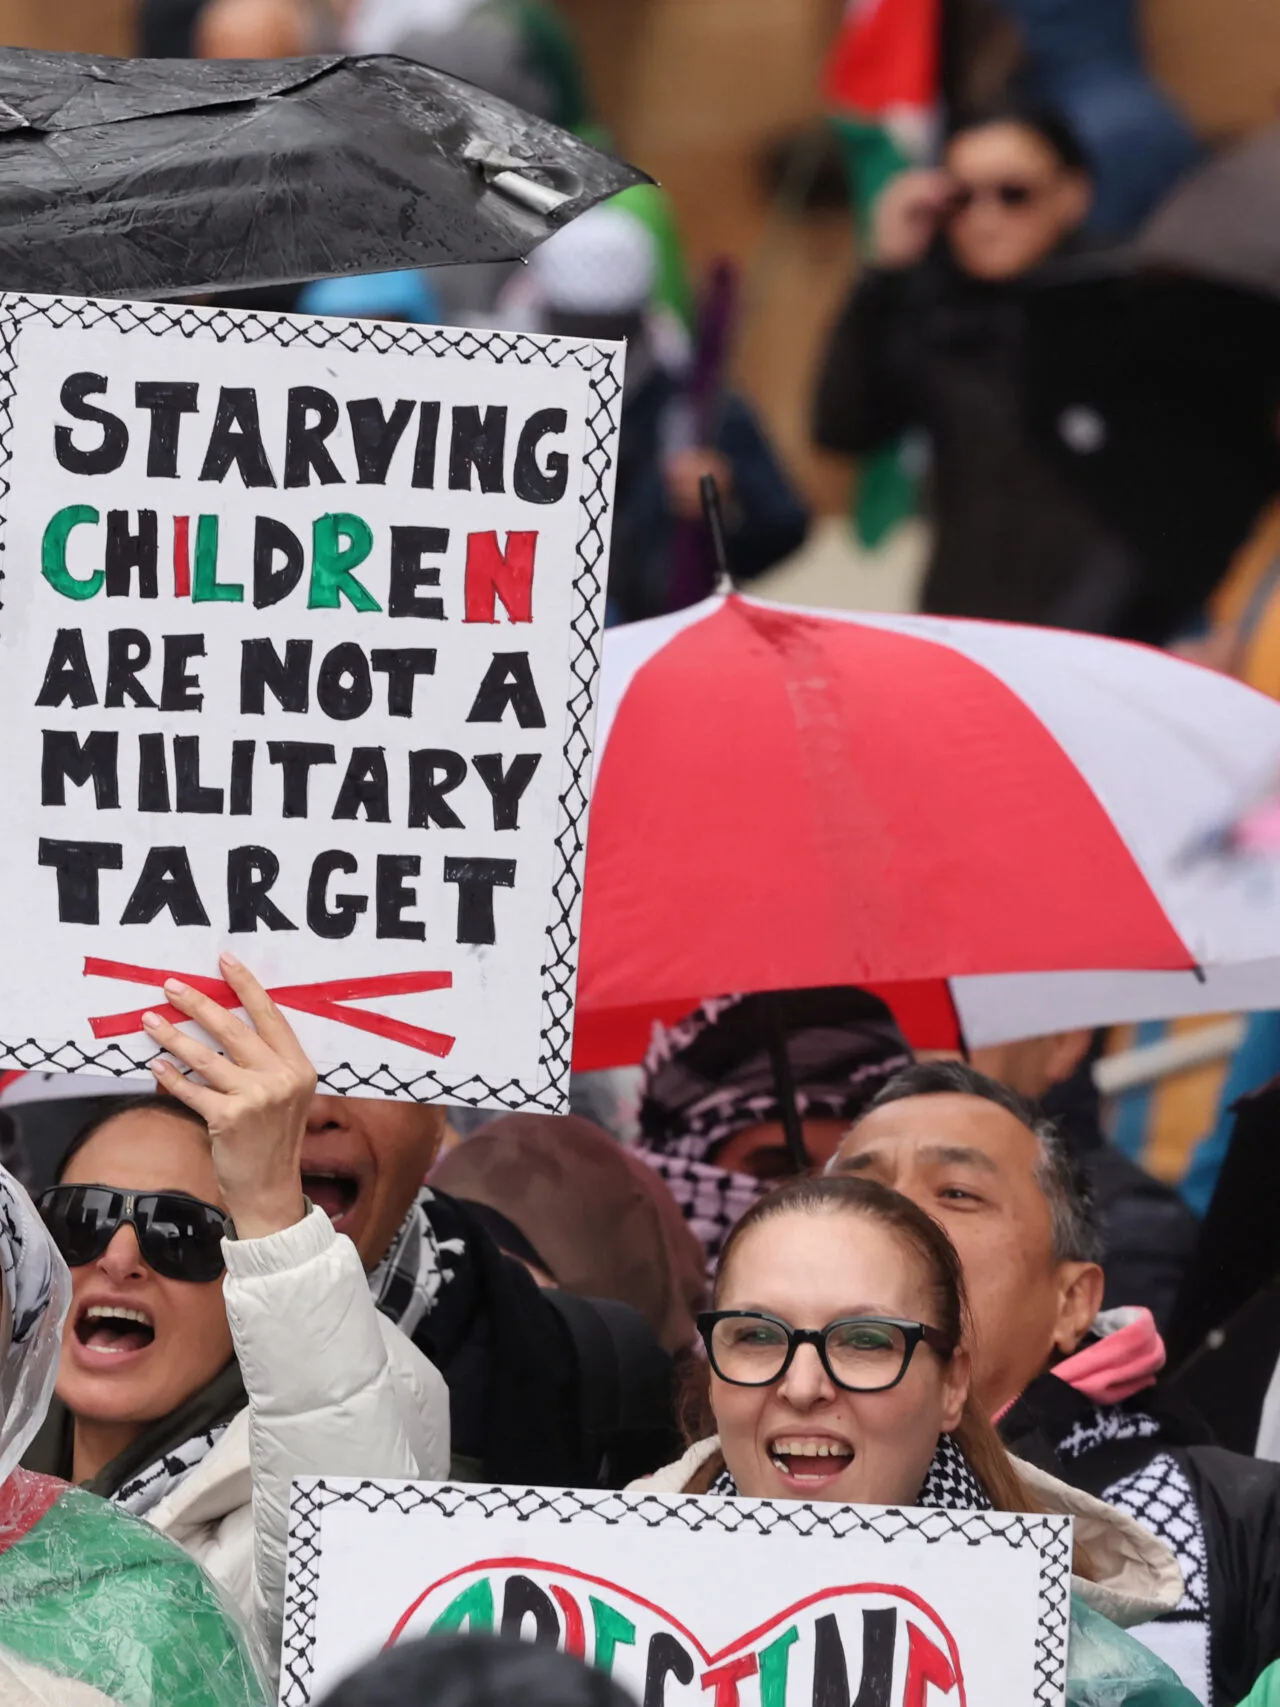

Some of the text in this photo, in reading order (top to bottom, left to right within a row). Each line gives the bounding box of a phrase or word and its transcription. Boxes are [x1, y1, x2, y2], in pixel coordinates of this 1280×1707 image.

[54, 372, 569, 505] STARVING
[41, 504, 539, 625] CHILDREN
[34, 628, 547, 729] ARE NOT A
[41, 729, 542, 832] MILITARY
[37, 837, 517, 946] TARGET
